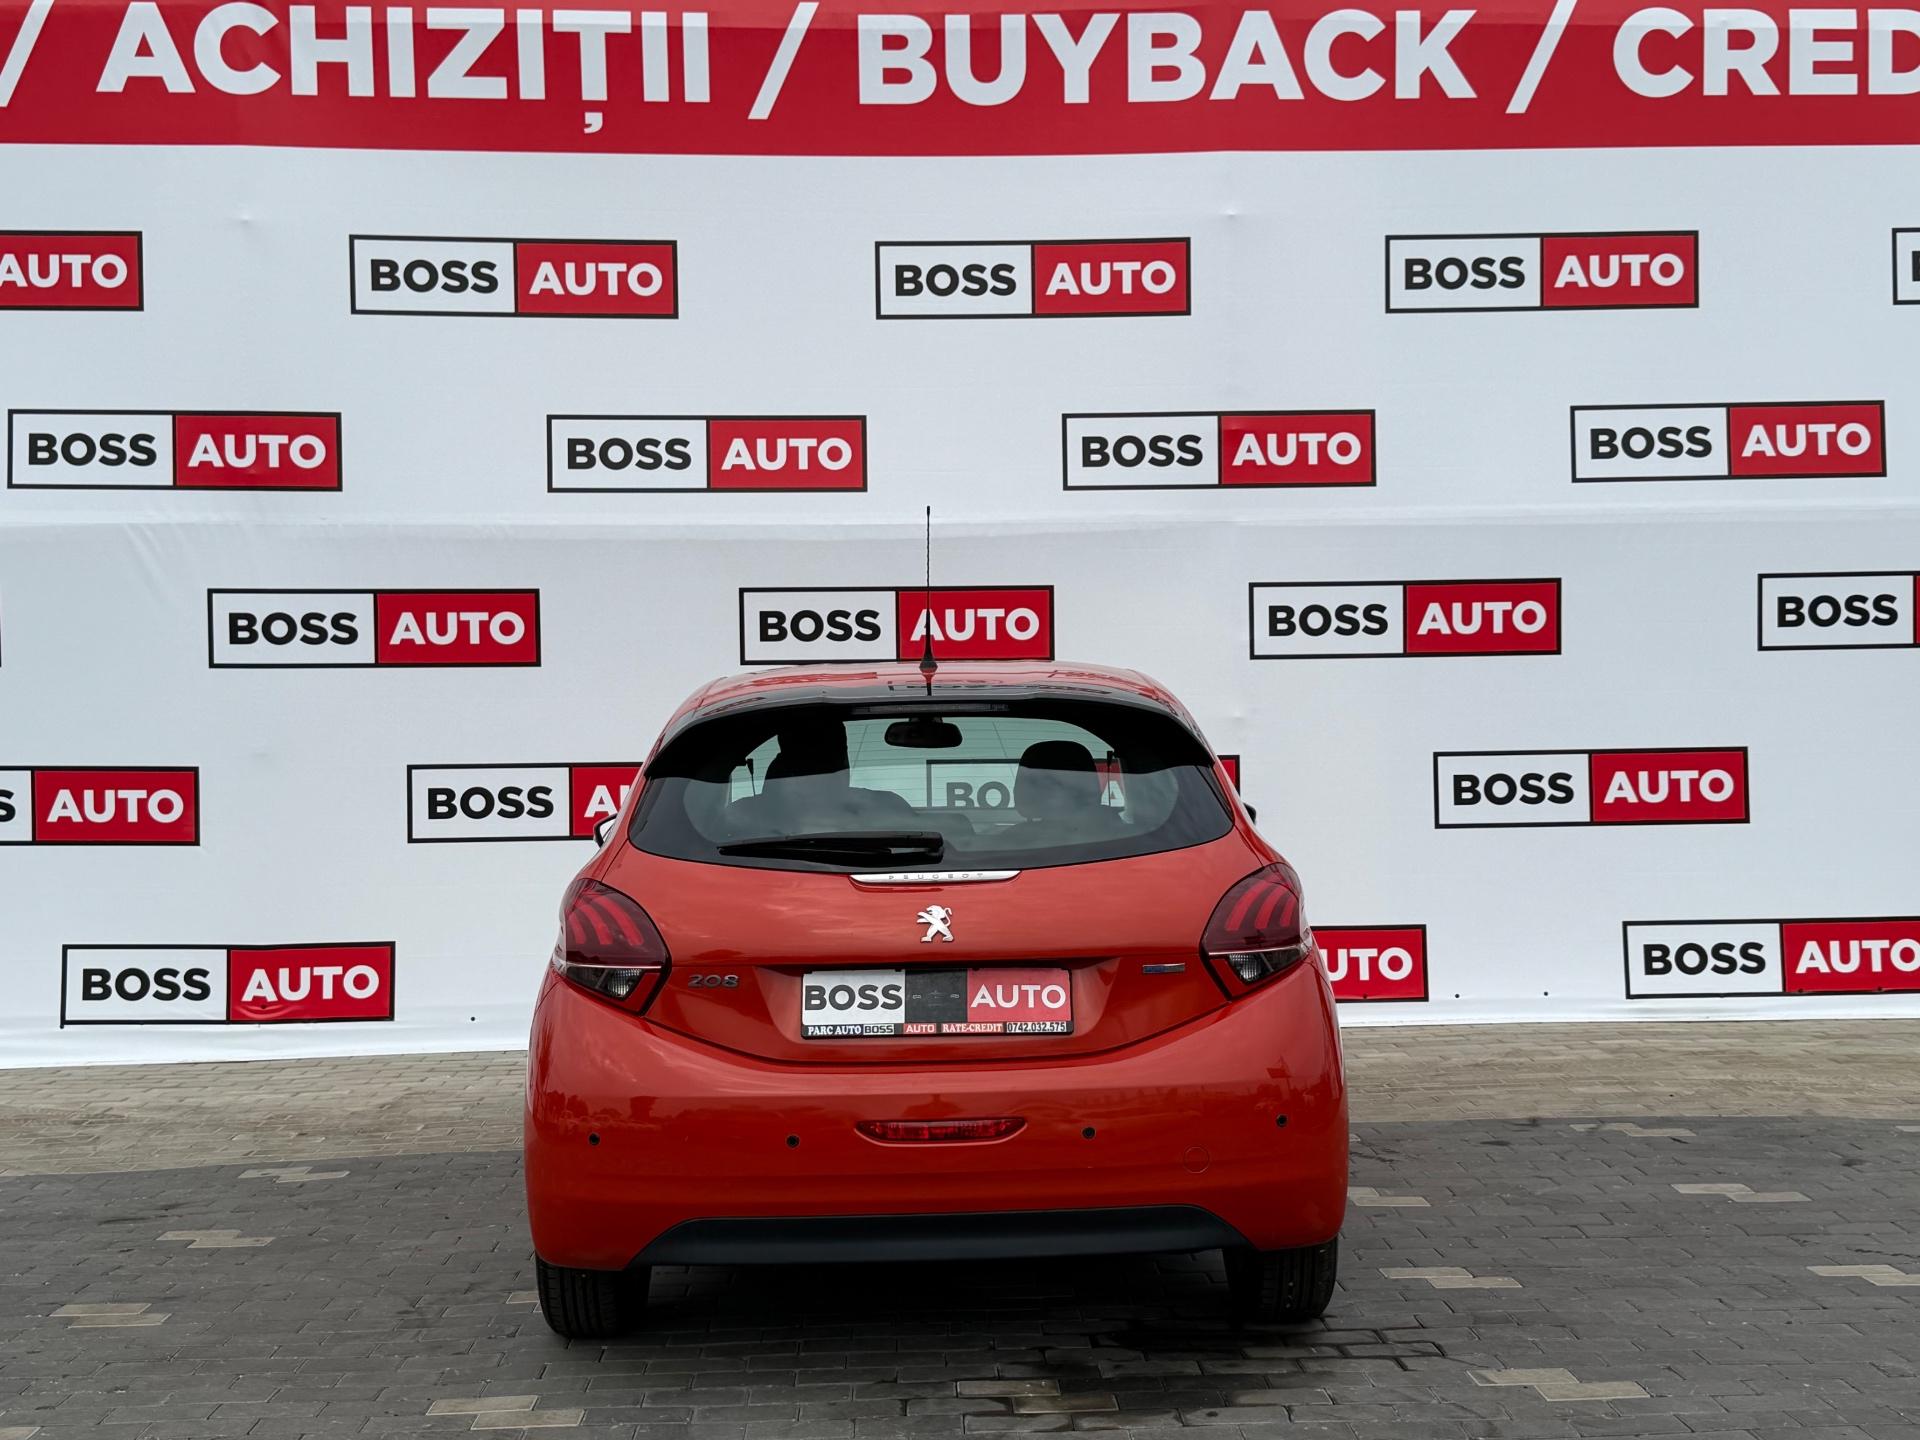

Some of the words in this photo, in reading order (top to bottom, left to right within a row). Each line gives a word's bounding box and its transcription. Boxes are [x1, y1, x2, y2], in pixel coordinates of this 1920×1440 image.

[96, 2, 709, 133] ACHIZIȚII
[749, 2, 819, 119] /
[858, 9, 1476, 105] BUYBACK
[1506, 0, 1577, 113] /
[1614, 7, 1920, 97] CRED
[0, 254, 127, 288] AUTO
[371, 259, 498, 293] BOSS
[530, 262, 662, 296] AUTO
[896, 264, 1016, 296] BOSS
[1046, 261, 1175, 295] AUTO
[1405, 257, 1525, 289] BOSS
[1555, 254, 1684, 287] AUTO
[29, 433, 156, 466] BOSS
[189, 434, 325, 468] AUTO
[568, 438, 691, 470] BOSS
[722, 438, 852, 470] AUTO
[1082, 435, 1202, 467] BOSS
[1232, 432, 1361, 465] AUTO
[1591, 426, 1711, 459] BOSS
[1742, 423, 1871, 456] AUTO
[760, 610, 881, 642] BOSS
[911, 608, 1039, 640] AUTO
[1269, 604, 1388, 636] BOSS
[1418, 601, 1546, 634] AUTO
[1778, 594, 1898, 627] BOSS
[229, 613, 358, 645] BOSS
[390, 612, 524, 644] AUTO
[428, 786, 553, 819] BOSS
[946, 781, 1011, 808] BO
[1454, 773, 1573, 805] BOSS
[1604, 770, 1733, 803] AUTO
[47, 790, 183, 822] AUTO
[1319, 947, 1413, 981] UTO
[1644, 942, 1765, 975] BOSS
[1796, 939, 1920, 973] AUTO
[83, 968, 210, 1001] BOSS
[242, 965, 379, 1001] AUTO
[688, 974, 739, 988] 208
[804, 984, 903, 1011] BOSS
[971, 984, 1066, 1009] AUTO
[808, 1026, 833, 1035] PARC
[834, 1025, 861, 1035] AUTO
[864, 1025, 894, 1034] BOSS
[905, 1024, 935, 1033] AUTO
[942, 1022, 1003, 1032] RATE-CREDIT
[1007, 1022, 1066, 1032] 0742.032.575
